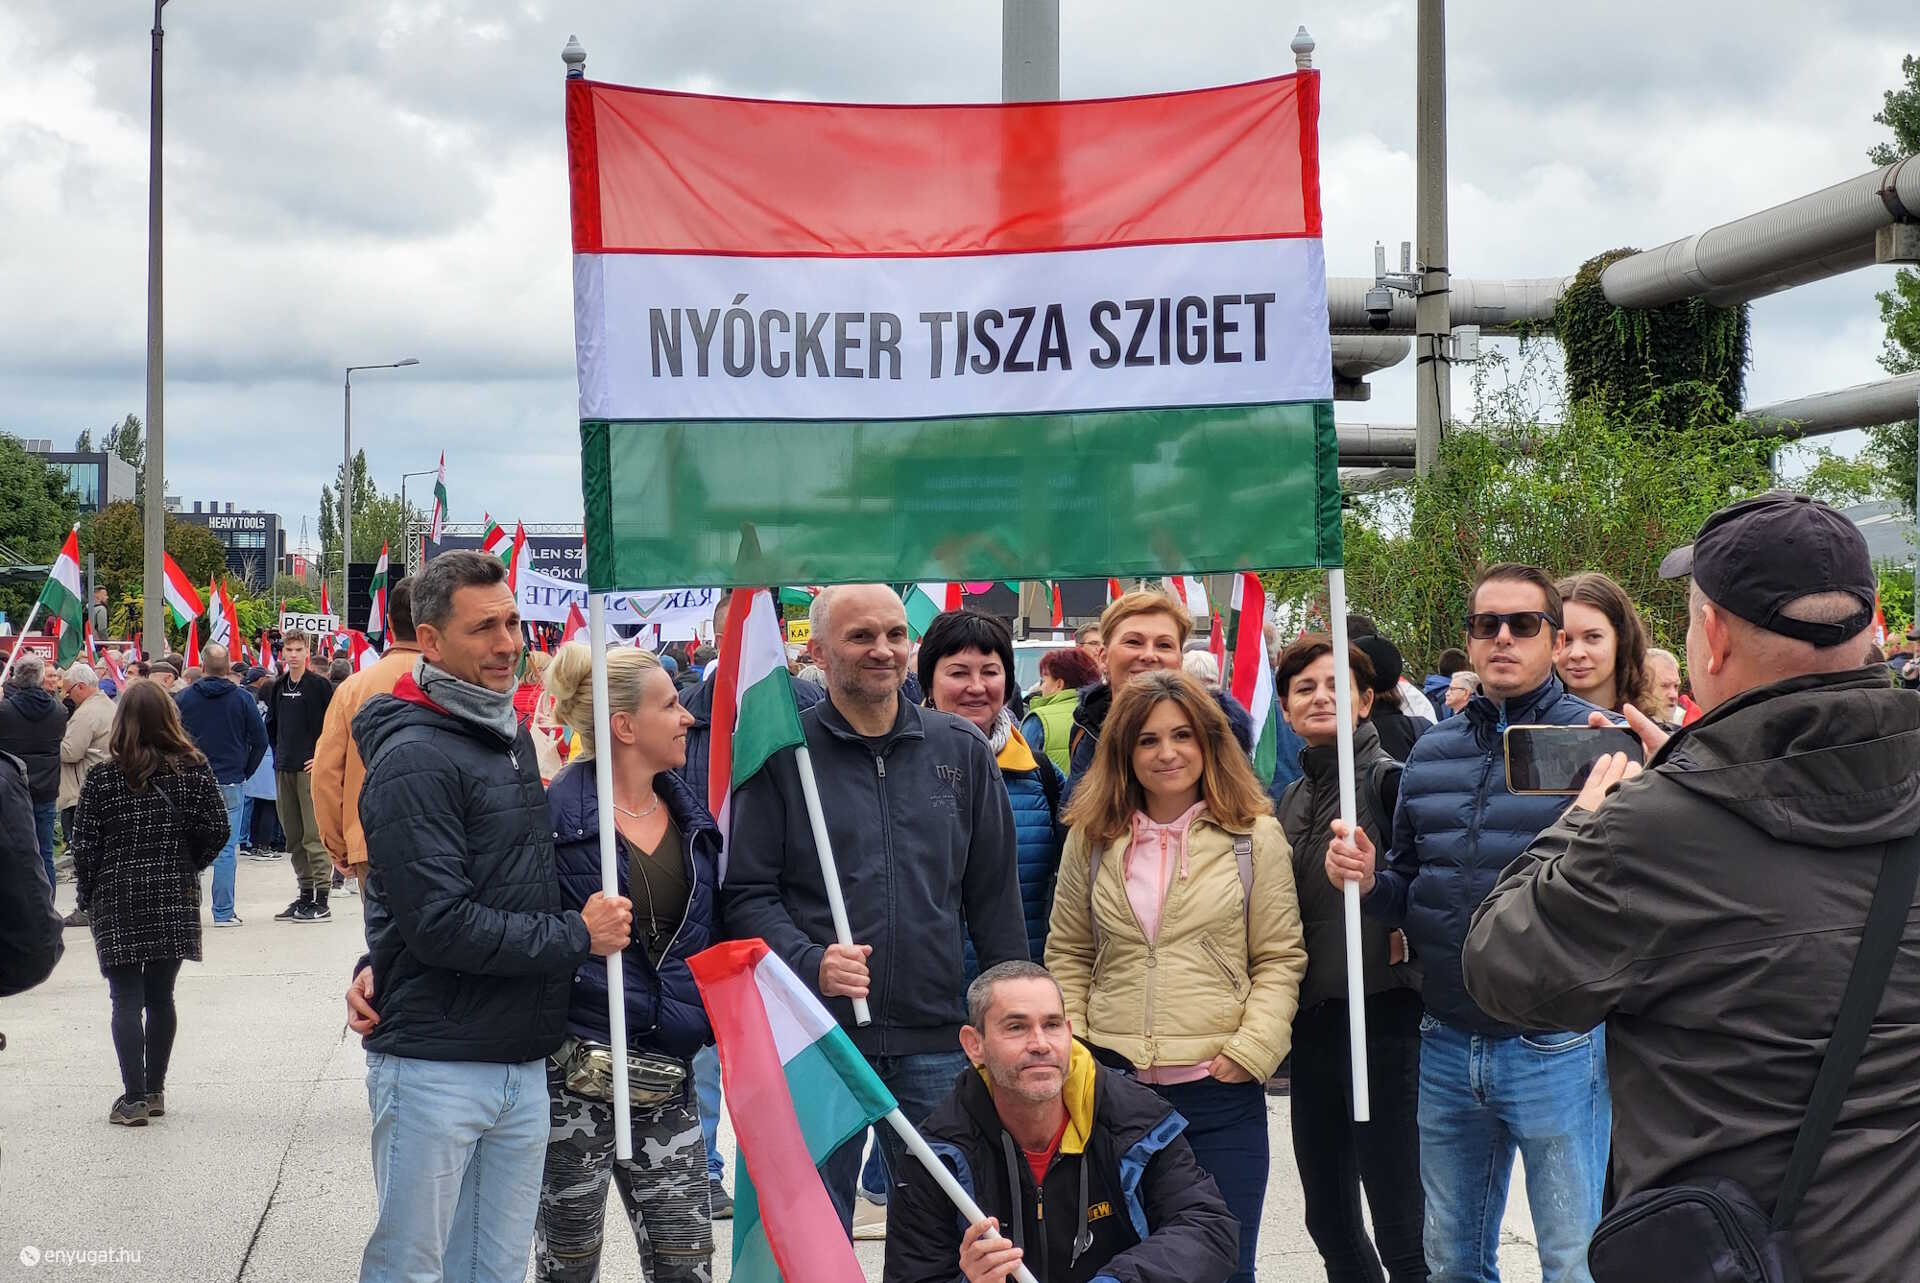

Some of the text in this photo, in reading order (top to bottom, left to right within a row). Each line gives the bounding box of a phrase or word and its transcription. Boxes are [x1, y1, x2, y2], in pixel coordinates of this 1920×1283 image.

[650, 293, 1277, 380] NYÓCKER TISZA SZIGET
[208, 516, 266, 529] HEAVY TOOLS
[284, 614, 332, 632] PÉCEL
